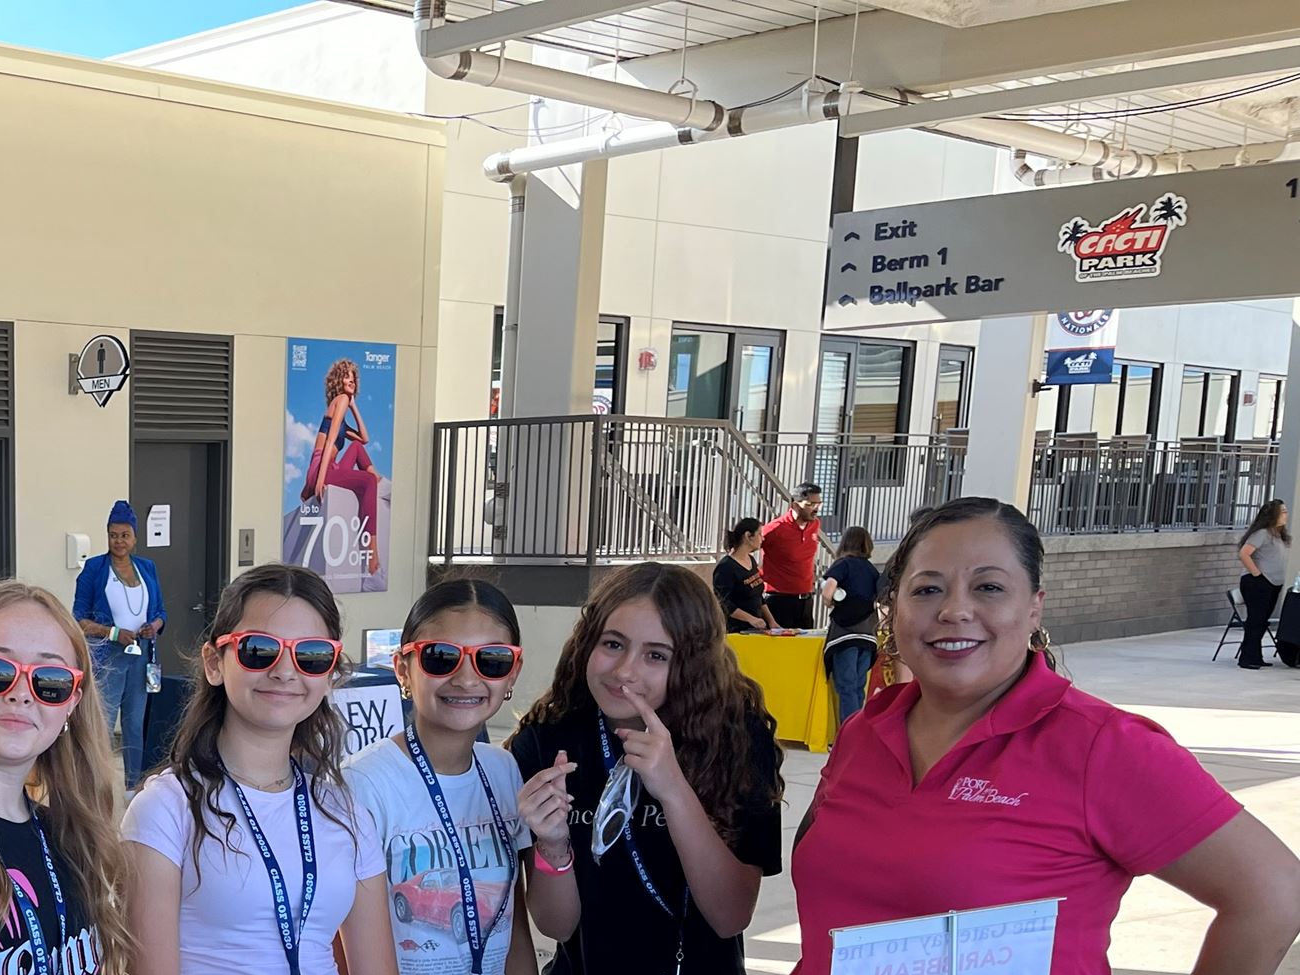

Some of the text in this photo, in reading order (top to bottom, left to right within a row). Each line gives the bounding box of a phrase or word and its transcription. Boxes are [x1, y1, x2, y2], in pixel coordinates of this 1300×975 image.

[874, 220, 917, 241] Exit
[1080, 230, 1163, 255] CACTI
[871, 247, 948, 273] Berm 1
[1081, 253, 1155, 271] PARK
[869, 275, 1004, 307] Ballpark Bar
[1061, 313, 1110, 336] NATIONALS
[364, 351, 390, 364] Tanger
[92, 378, 110, 390] MEN
[300, 504, 320, 515] Up to
[300, 515, 372, 568] 70%
[348, 549, 374, 566] OFF
[416, 755, 436, 785] CLASS
[962, 776, 991, 790] PORT
[296, 793, 306, 819] 2030
[984, 788, 1030, 808] Beach
[434, 794, 465, 868] CLASS OF 2030
[255, 834, 271, 859] 2030
[304, 833, 313, 864] CLASS
[631, 850, 649, 882] CLASS
[49, 870, 63, 903] CLASS
[305, 873, 314, 901] 2030
[271, 868, 293, 950] CLASS OF 2030
[462, 877, 479, 950] CLASS OF 2030
[25, 908, 44, 949] CLASS
[36, 948, 46, 964] OF
